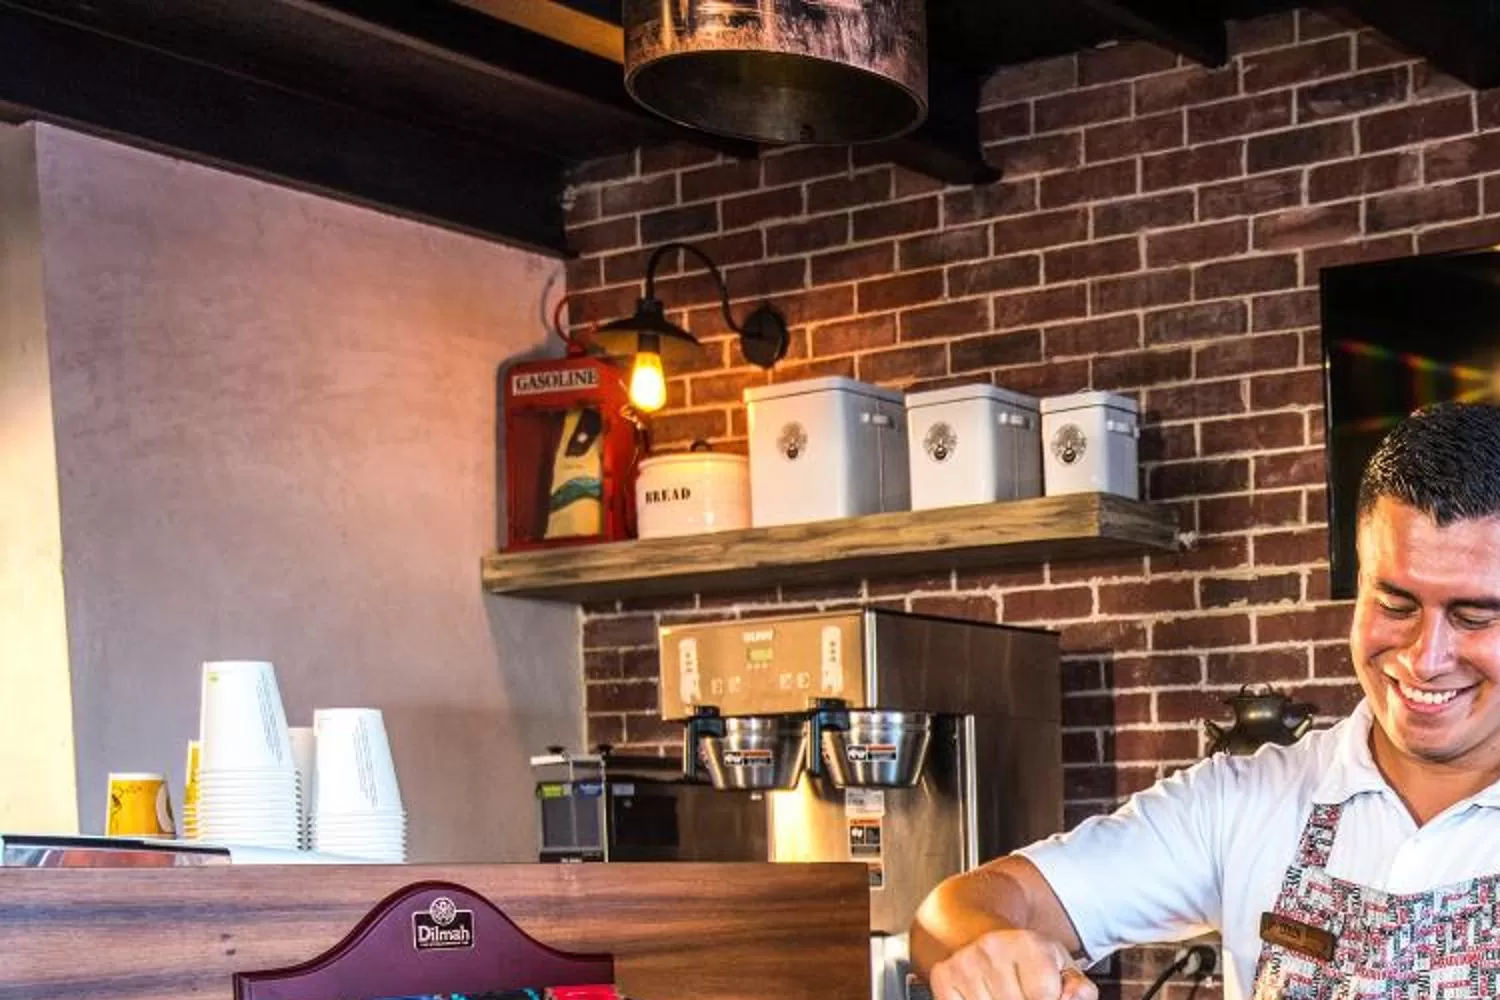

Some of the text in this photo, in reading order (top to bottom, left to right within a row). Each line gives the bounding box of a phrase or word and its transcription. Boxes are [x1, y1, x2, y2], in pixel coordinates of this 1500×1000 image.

[516, 371, 596, 390] GASOLINE
[645, 487, 691, 505] BREAD
[417, 924, 471, 943] Dilmah
